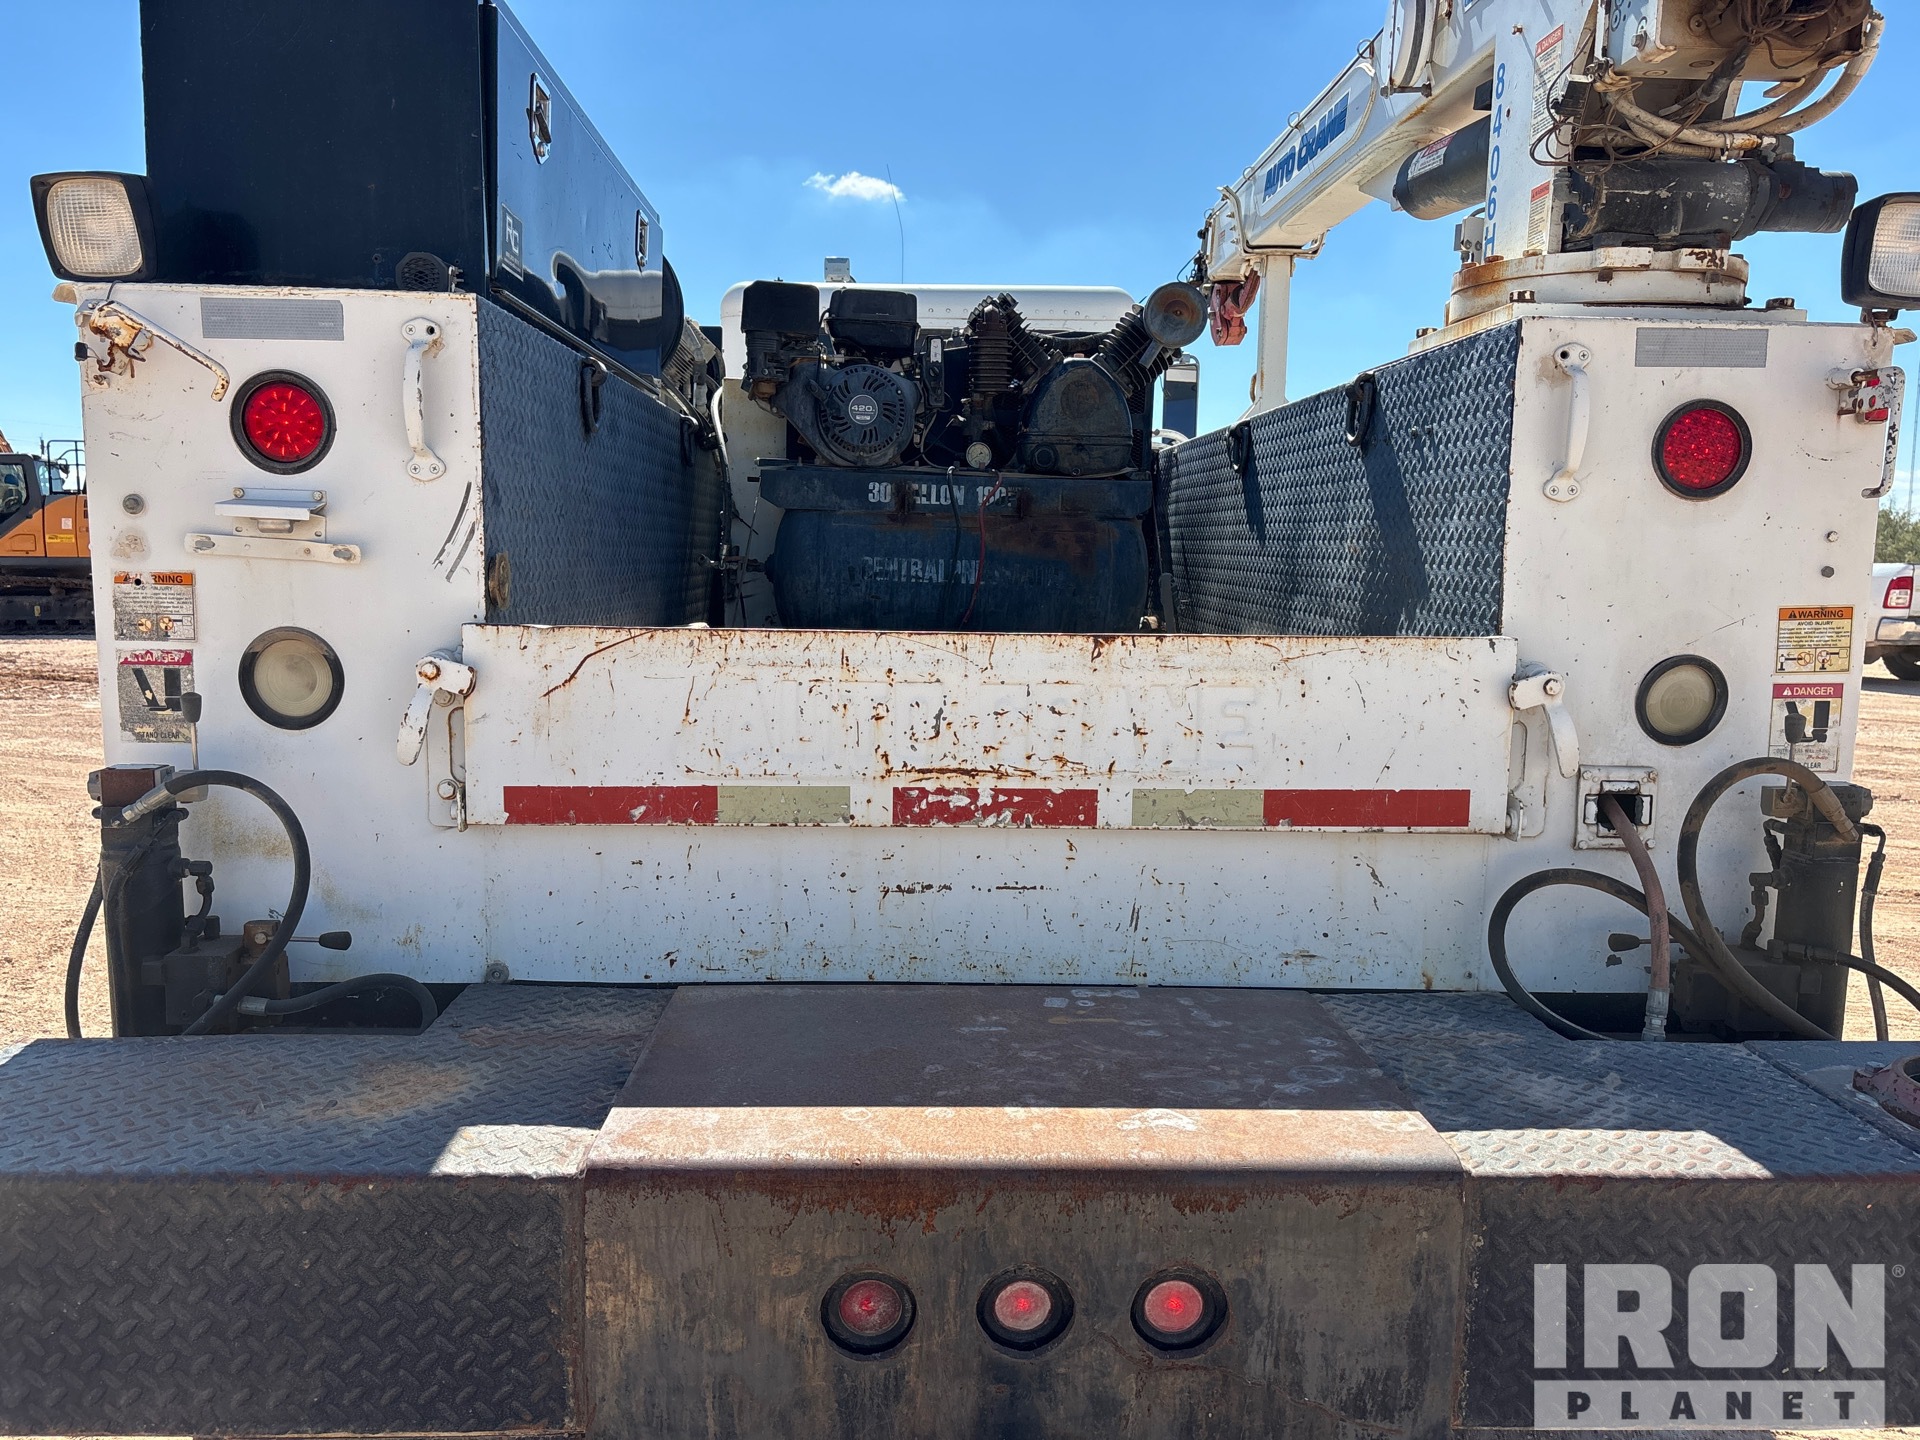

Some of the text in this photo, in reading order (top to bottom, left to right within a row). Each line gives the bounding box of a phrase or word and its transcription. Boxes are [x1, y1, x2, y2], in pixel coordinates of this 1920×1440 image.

[1541, 29, 1563, 52] DANGER
[1262, 92, 1350, 204] AUTO CRANE
[868, 481, 892, 503] 30
[1798, 609, 1844, 619] WARNING
[1793, 686, 1834, 696] DANGER
